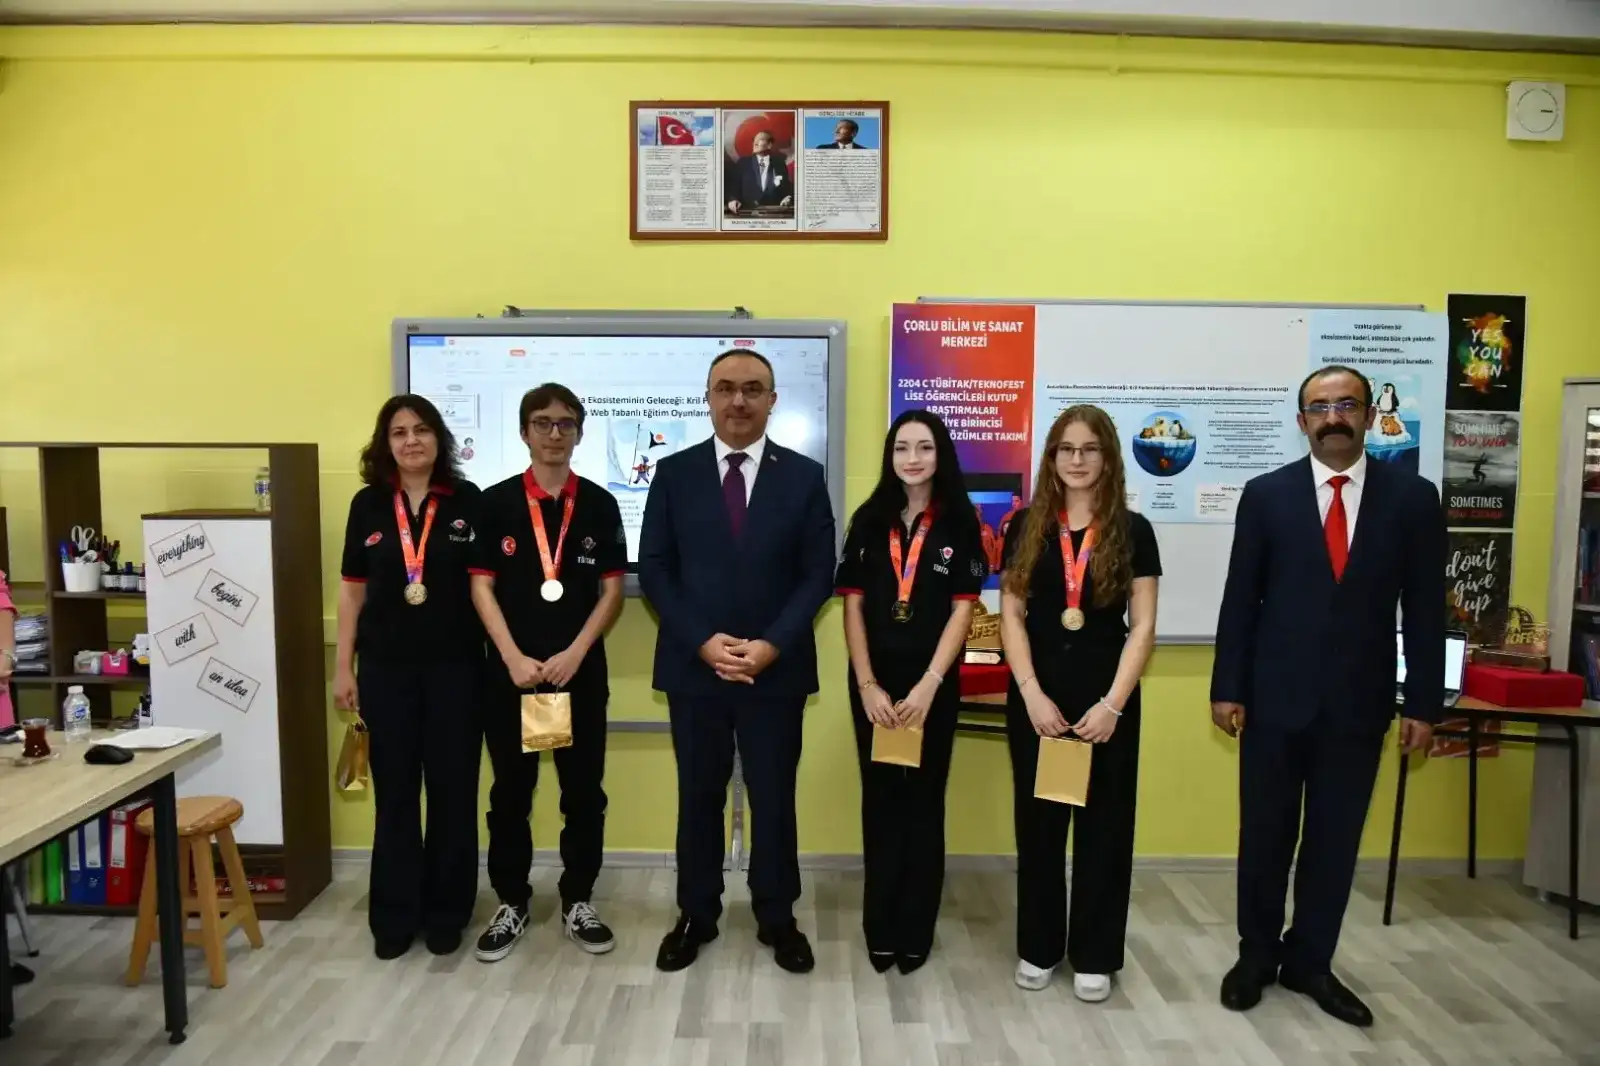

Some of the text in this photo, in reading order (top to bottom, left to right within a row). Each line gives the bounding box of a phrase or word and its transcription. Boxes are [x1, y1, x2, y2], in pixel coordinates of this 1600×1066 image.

[903, 316, 1024, 334] ÇORLU BİLİM VE SANAT
[941, 333, 988, 348] MERKEZİ
[1471, 328, 1503, 343] YES
[1468, 345, 1502, 360] YOU
[1467, 363, 1503, 379] CAN
[897, 376, 1025, 390] 2204 C TÜBİTAK/TEKNOFEST
[588, 396, 645, 405] Ekosisteminin
[646, 396, 685, 406] Geleceği:
[686, 396, 701, 405] Kril
[904, 389, 1018, 403] LİSE ÖĞRENCİLERİ KUTUP
[590, 408, 609, 417] Web
[611, 408, 641, 417] Tabanlı
[643, 408, 669, 418] Eğitim
[926, 405, 999, 417] ARAŞTIRMALARI
[960, 416, 1003, 429] BİRİNCİSİ
[1454, 423, 1507, 436] SOMETIMES
[949, 429, 993, 441] ÖZÜMLER
[1450, 495, 1503, 509] SOMETIMES
[157, 533, 206, 565] everything
[1445, 540, 1497, 578] don't
[210, 581, 243, 608] begins
[1454, 572, 1496, 608] give
[1464, 593, 1492, 622] up
[175, 622, 197, 647] with
[208, 671, 248, 698] an idea
